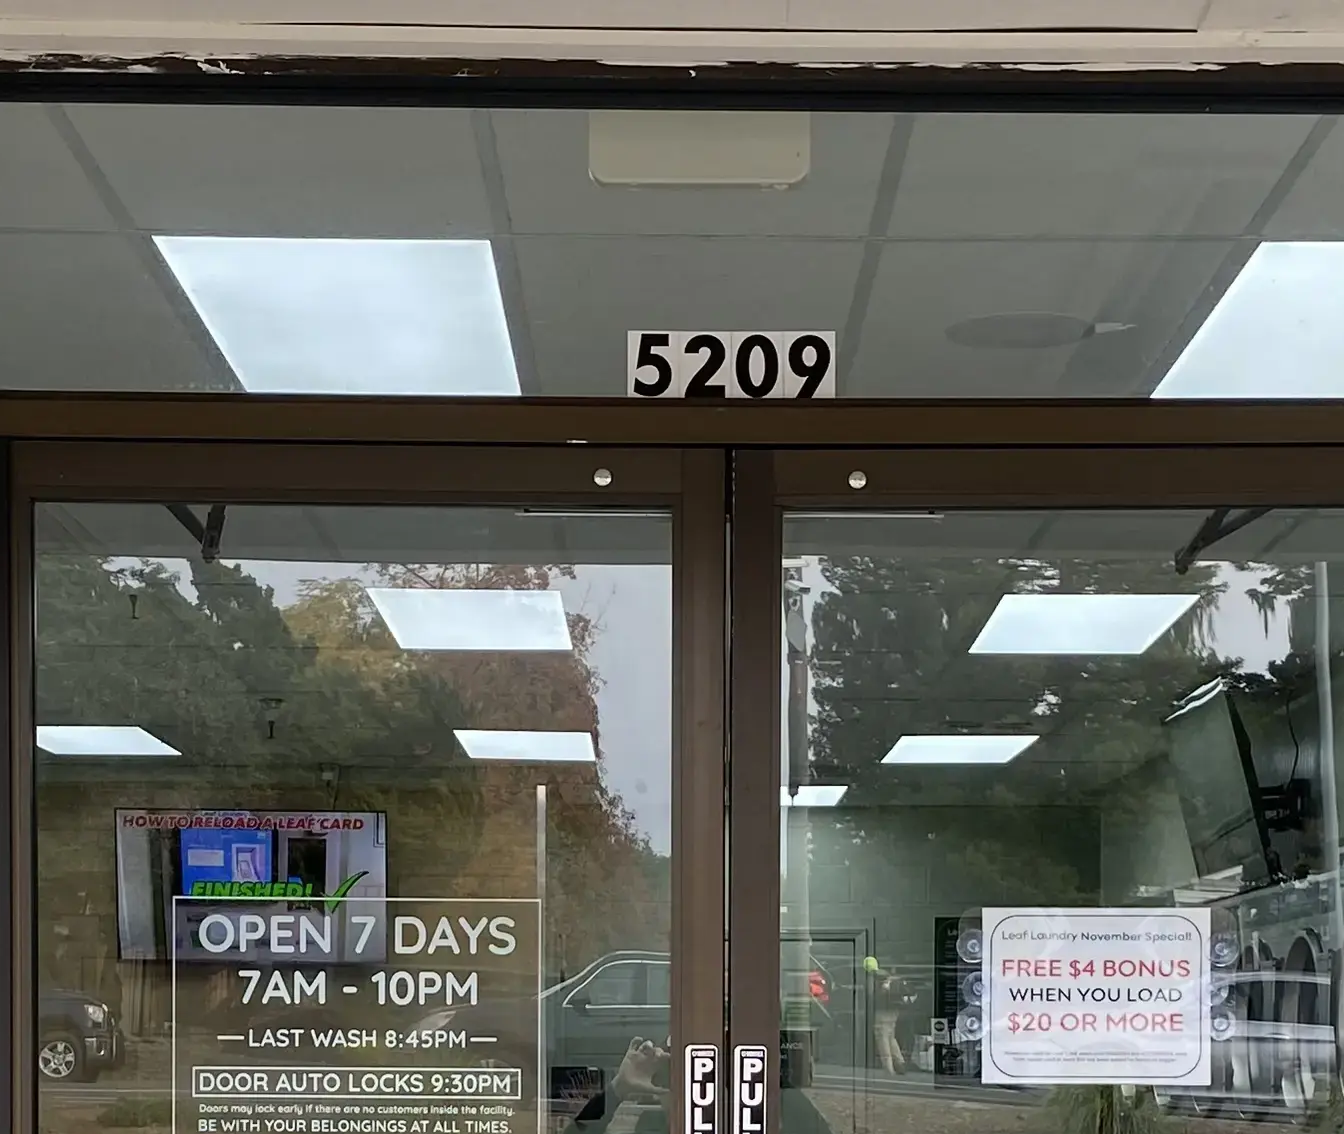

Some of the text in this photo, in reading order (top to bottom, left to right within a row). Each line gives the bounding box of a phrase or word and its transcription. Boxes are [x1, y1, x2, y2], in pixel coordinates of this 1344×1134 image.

[634, 333, 831, 399] 5209
[122, 815, 165, 828] HOW
[167, 815, 191, 829] TO
[192, 815, 261, 829] RELOAD
[260, 817, 273, 830] A
[320, 817, 364, 830] CARD
[197, 913, 517, 956] OPEN 7 DAYS
[1002, 931, 1028, 942] Leaf
[1030, 931, 1078, 943] Laundry
[1081, 931, 1142, 942] November
[1002, 959, 1191, 979] FREE $4 BONUS
[238, 970, 327, 1006] 7AM
[371, 970, 479, 1006] 10PM
[1009, 988, 1182, 1002] WHEN YOU LOAD
[1007, 1012, 1184, 1034] $20 OR MORE
[247, 1028, 467, 1049] LAST WASH 8:45PM
[198, 1072, 512, 1094] DOOR AUTO LOCKS 9:30PM
[199, 1104, 228, 1114] Doors
[231, 1105, 252, 1116] may
[255, 1104, 275, 1114] lock
[278, 1105, 303, 1116] early
[315, 1104, 341, 1114] there
[344, 1104, 360, 1114] are
[363, 1104, 375, 1114] no
[377, 1104, 428, 1114] customers
[430, 1104, 458, 1114] inside
[461, 1104, 477, 1114] the
[479, 1105, 516, 1116] facility.
[198, 1119, 512, 1134] BE WITH YOUR BELONGINGS AT ALL TIMES.
